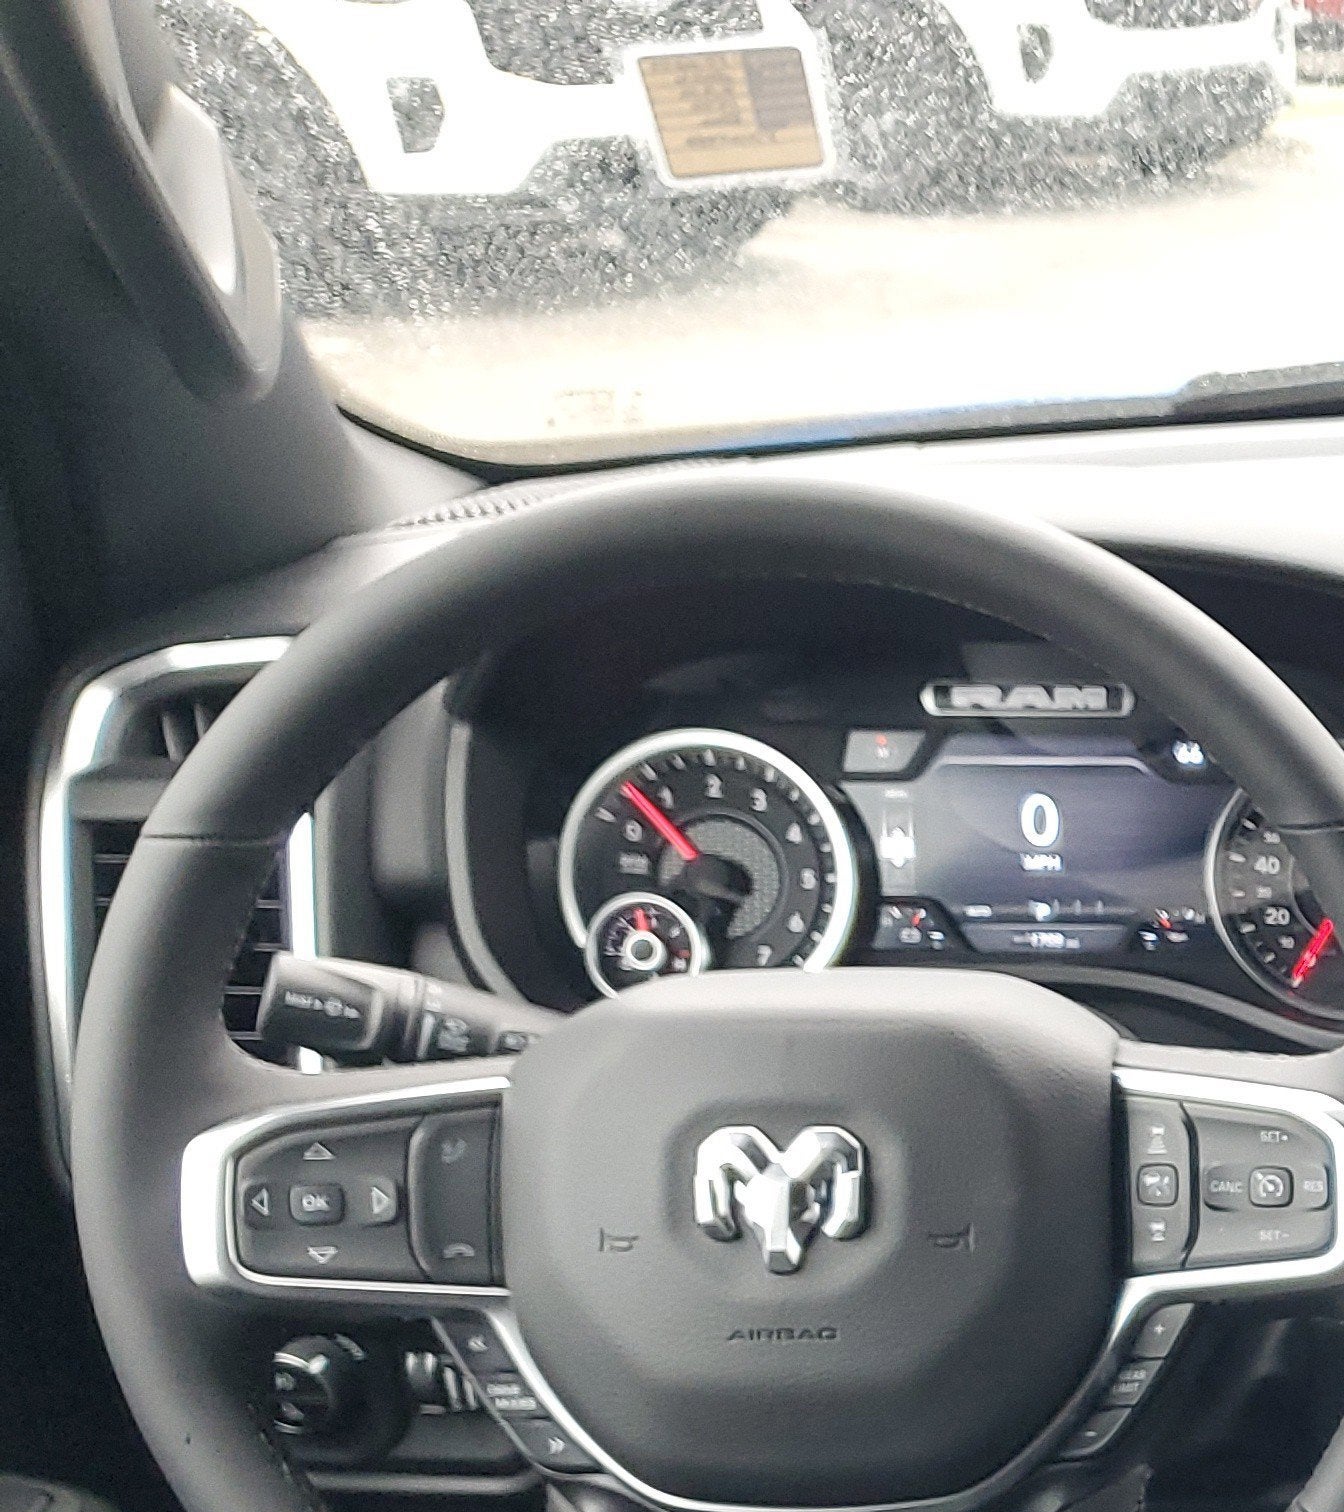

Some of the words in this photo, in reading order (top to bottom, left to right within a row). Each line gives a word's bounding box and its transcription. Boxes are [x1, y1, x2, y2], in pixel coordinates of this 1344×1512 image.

[951, 685, 1108, 711] RAM
[1020, 792, 1060, 847] 0
[1254, 855, 1280, 874] 40
[1264, 906, 1291, 925] 20
[726, 1327, 839, 1342] AIRBAG
